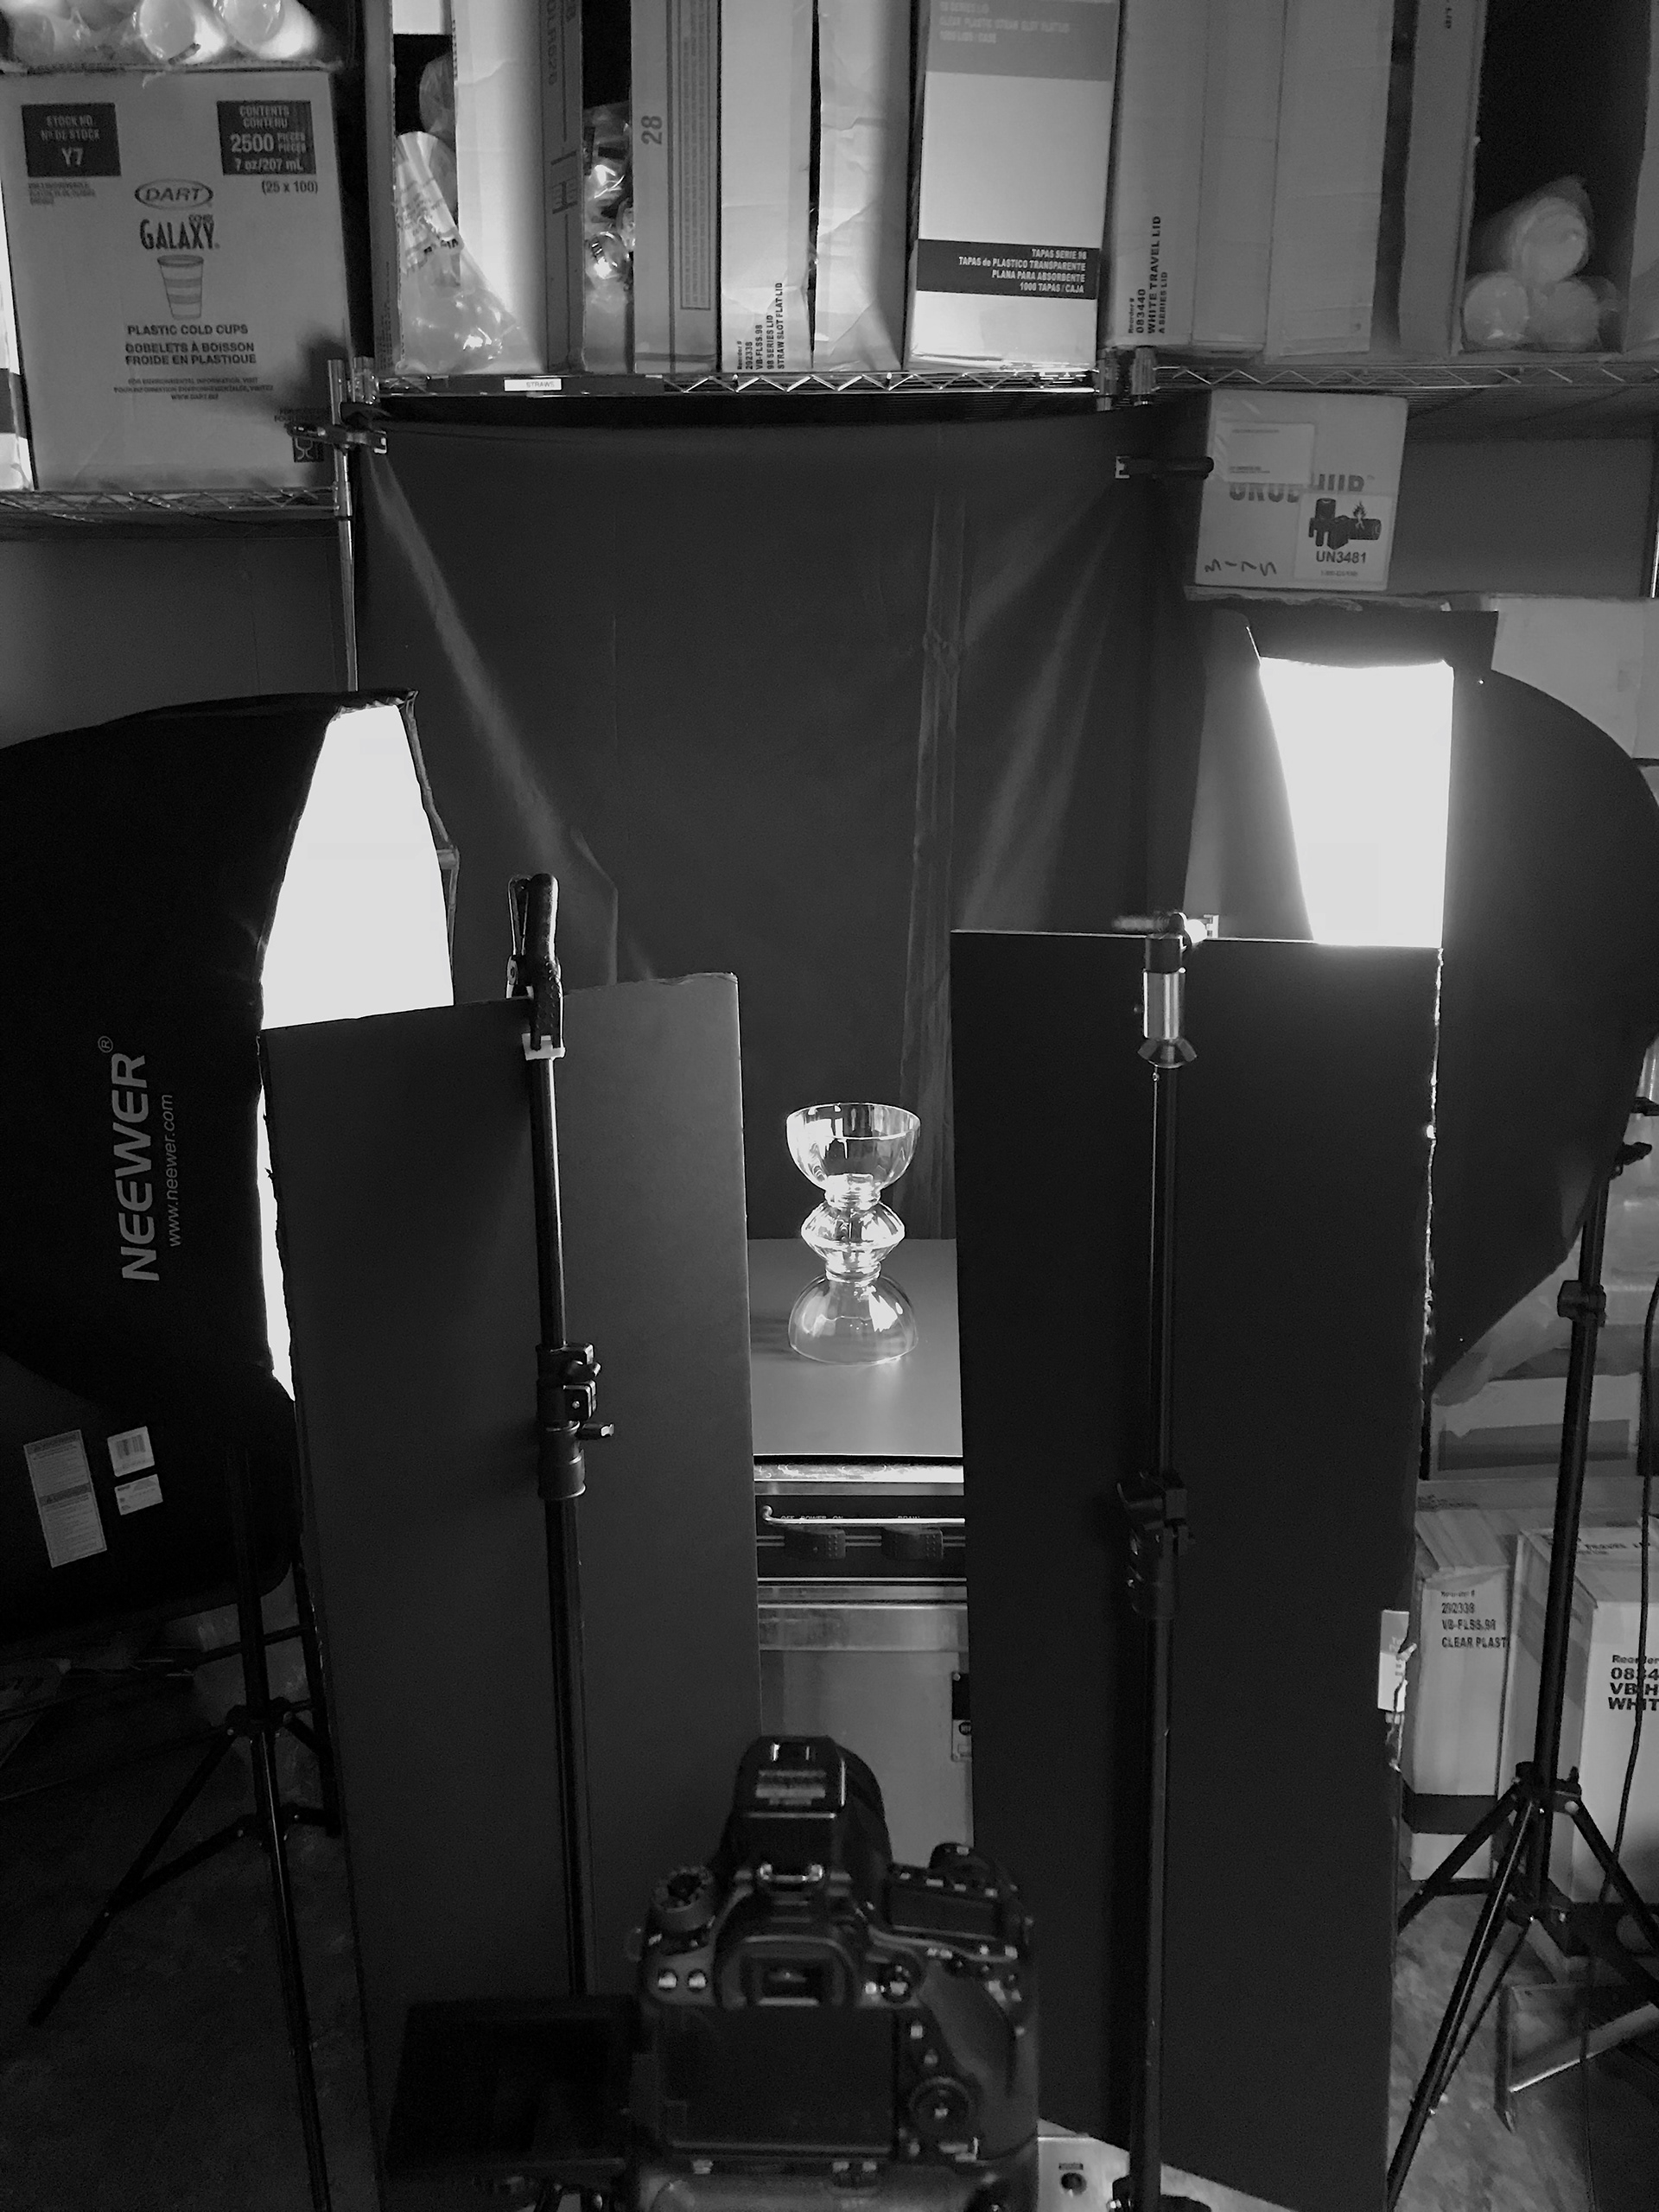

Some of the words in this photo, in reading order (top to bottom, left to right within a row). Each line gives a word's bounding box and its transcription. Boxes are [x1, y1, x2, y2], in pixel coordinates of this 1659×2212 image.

[640, 114, 664, 145] 28
[230, 132, 275, 154] 2500
[61, 147, 85, 167] Y7
[234, 157, 242, 172] 7
[145, 187, 204, 201] DART
[292, 180, 319, 195] 100)
[139, 218, 214, 251] GALAXY
[1151, 215, 1161, 238] LID
[1032, 248, 1054, 258] TAPAS
[1055, 250, 1077, 259] SERIE
[958, 256, 981, 266] TAPAS
[982, 257, 992, 267] de
[1029, 260, 1086, 271] TRANSPARENTE
[1148, 239, 1160, 290] TRAVEL
[991, 270, 1015, 279] PLANA
[1017, 270, 1036, 280] PARA
[1037, 272, 1086, 283] ABSORBENTE
[1160, 271, 1168, 288] LID
[774, 282, 783, 296] LID
[1020, 281, 1037, 291] 1000
[1038, 283, 1060, 293] TAPAS
[1065, 283, 1084, 294] CAJA
[774, 296, 784, 318] FLAT
[1135, 288, 1146, 334] 083440
[1147, 292, 1159, 334] WHITE
[1158, 289, 1167, 326] SERIES
[766, 314, 774, 328] LID
[126, 324, 178, 336] PLASTIC
[180, 323, 213, 335] COLD
[215, 323, 249, 335] CUPS
[775, 319, 785, 340] SLOT
[124, 341, 189, 354] GOBELETS
[201, 341, 255, 353] BOISSON
[766, 328, 775, 359] SERIES
[124, 354, 170, 366] FROIDE
[172, 354, 189, 365] EN
[191, 353, 257, 365] PLASTIQUE
[776, 340, 785, 370] STRAW
[525, 380, 556, 389] STRAWS
[1315, 550, 1367, 564] UN3481
[111, 1052, 160, 1281] NEEWER
[162, 1094, 181, 1248] www.neewer.com
[1441, 1636, 1473, 1649] CLEAR
[1611, 1667, 1659, 1681] 084
